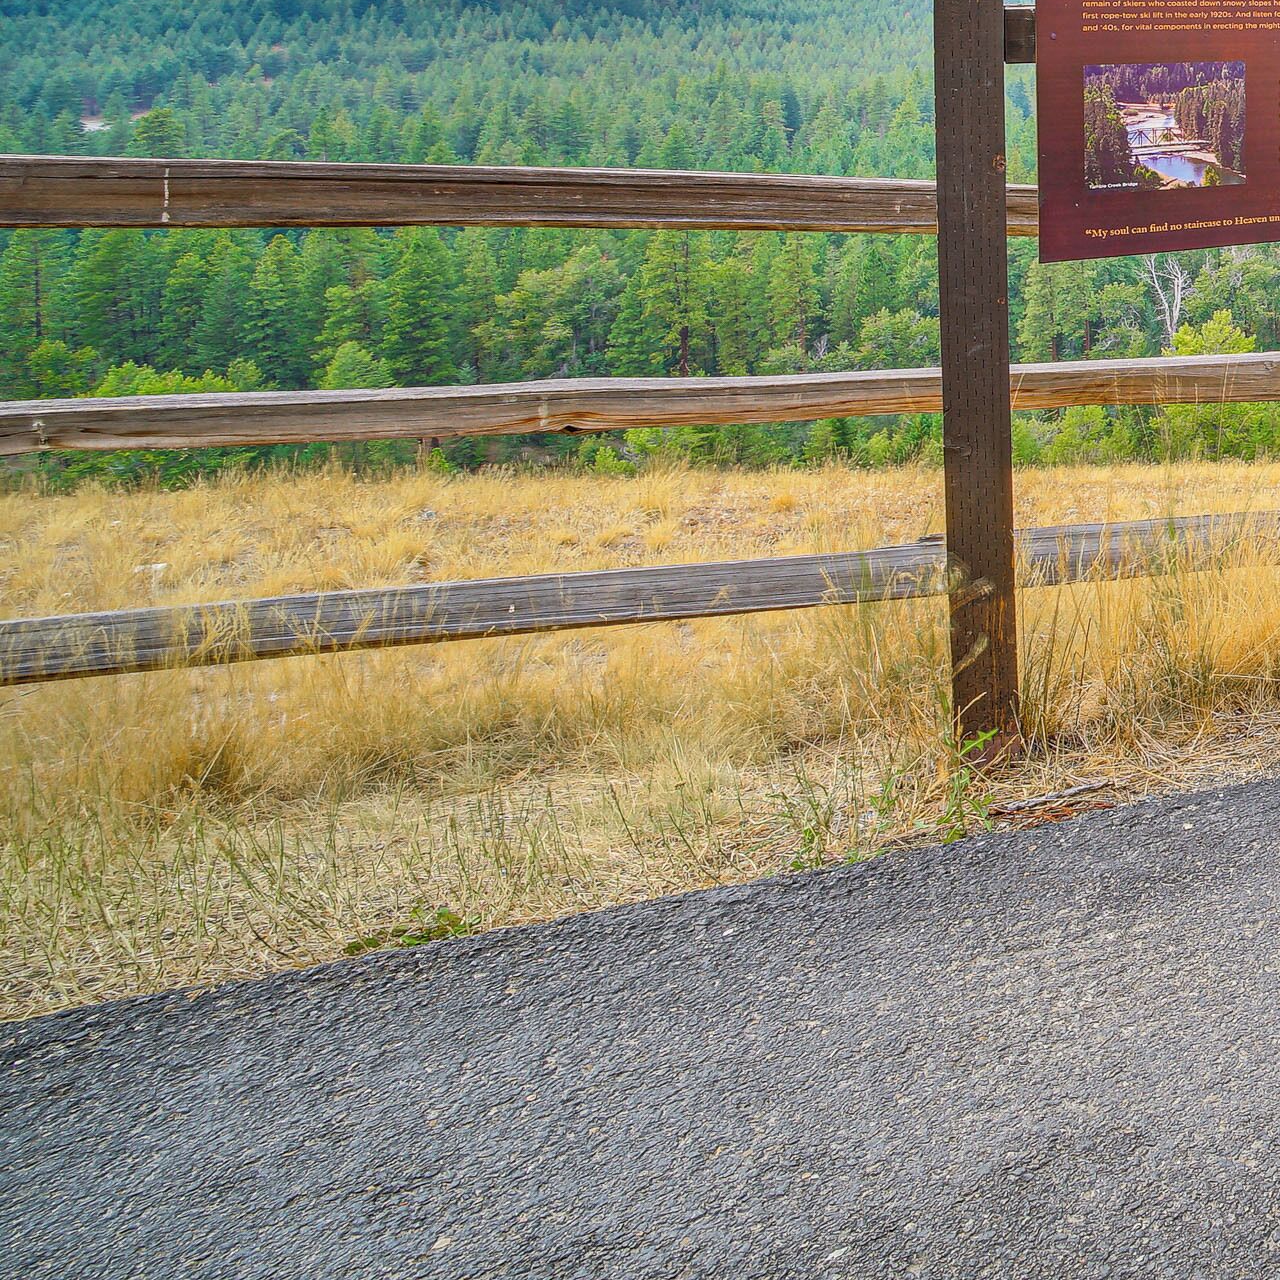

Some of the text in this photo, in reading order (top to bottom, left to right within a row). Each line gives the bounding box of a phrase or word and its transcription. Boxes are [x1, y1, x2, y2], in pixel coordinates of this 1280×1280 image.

[1153, 23, 1202, 31] components
[1212, 22, 1243, 30] erecting
[1085, 227, 1108, 240] "My
[1110, 225, 1129, 235] soul
[1149, 222, 1168, 232] find
[1183, 218, 1221, 229] staircase
[1222, 217, 1232, 226] to
[1234, 214, 1267, 225] Heaven
